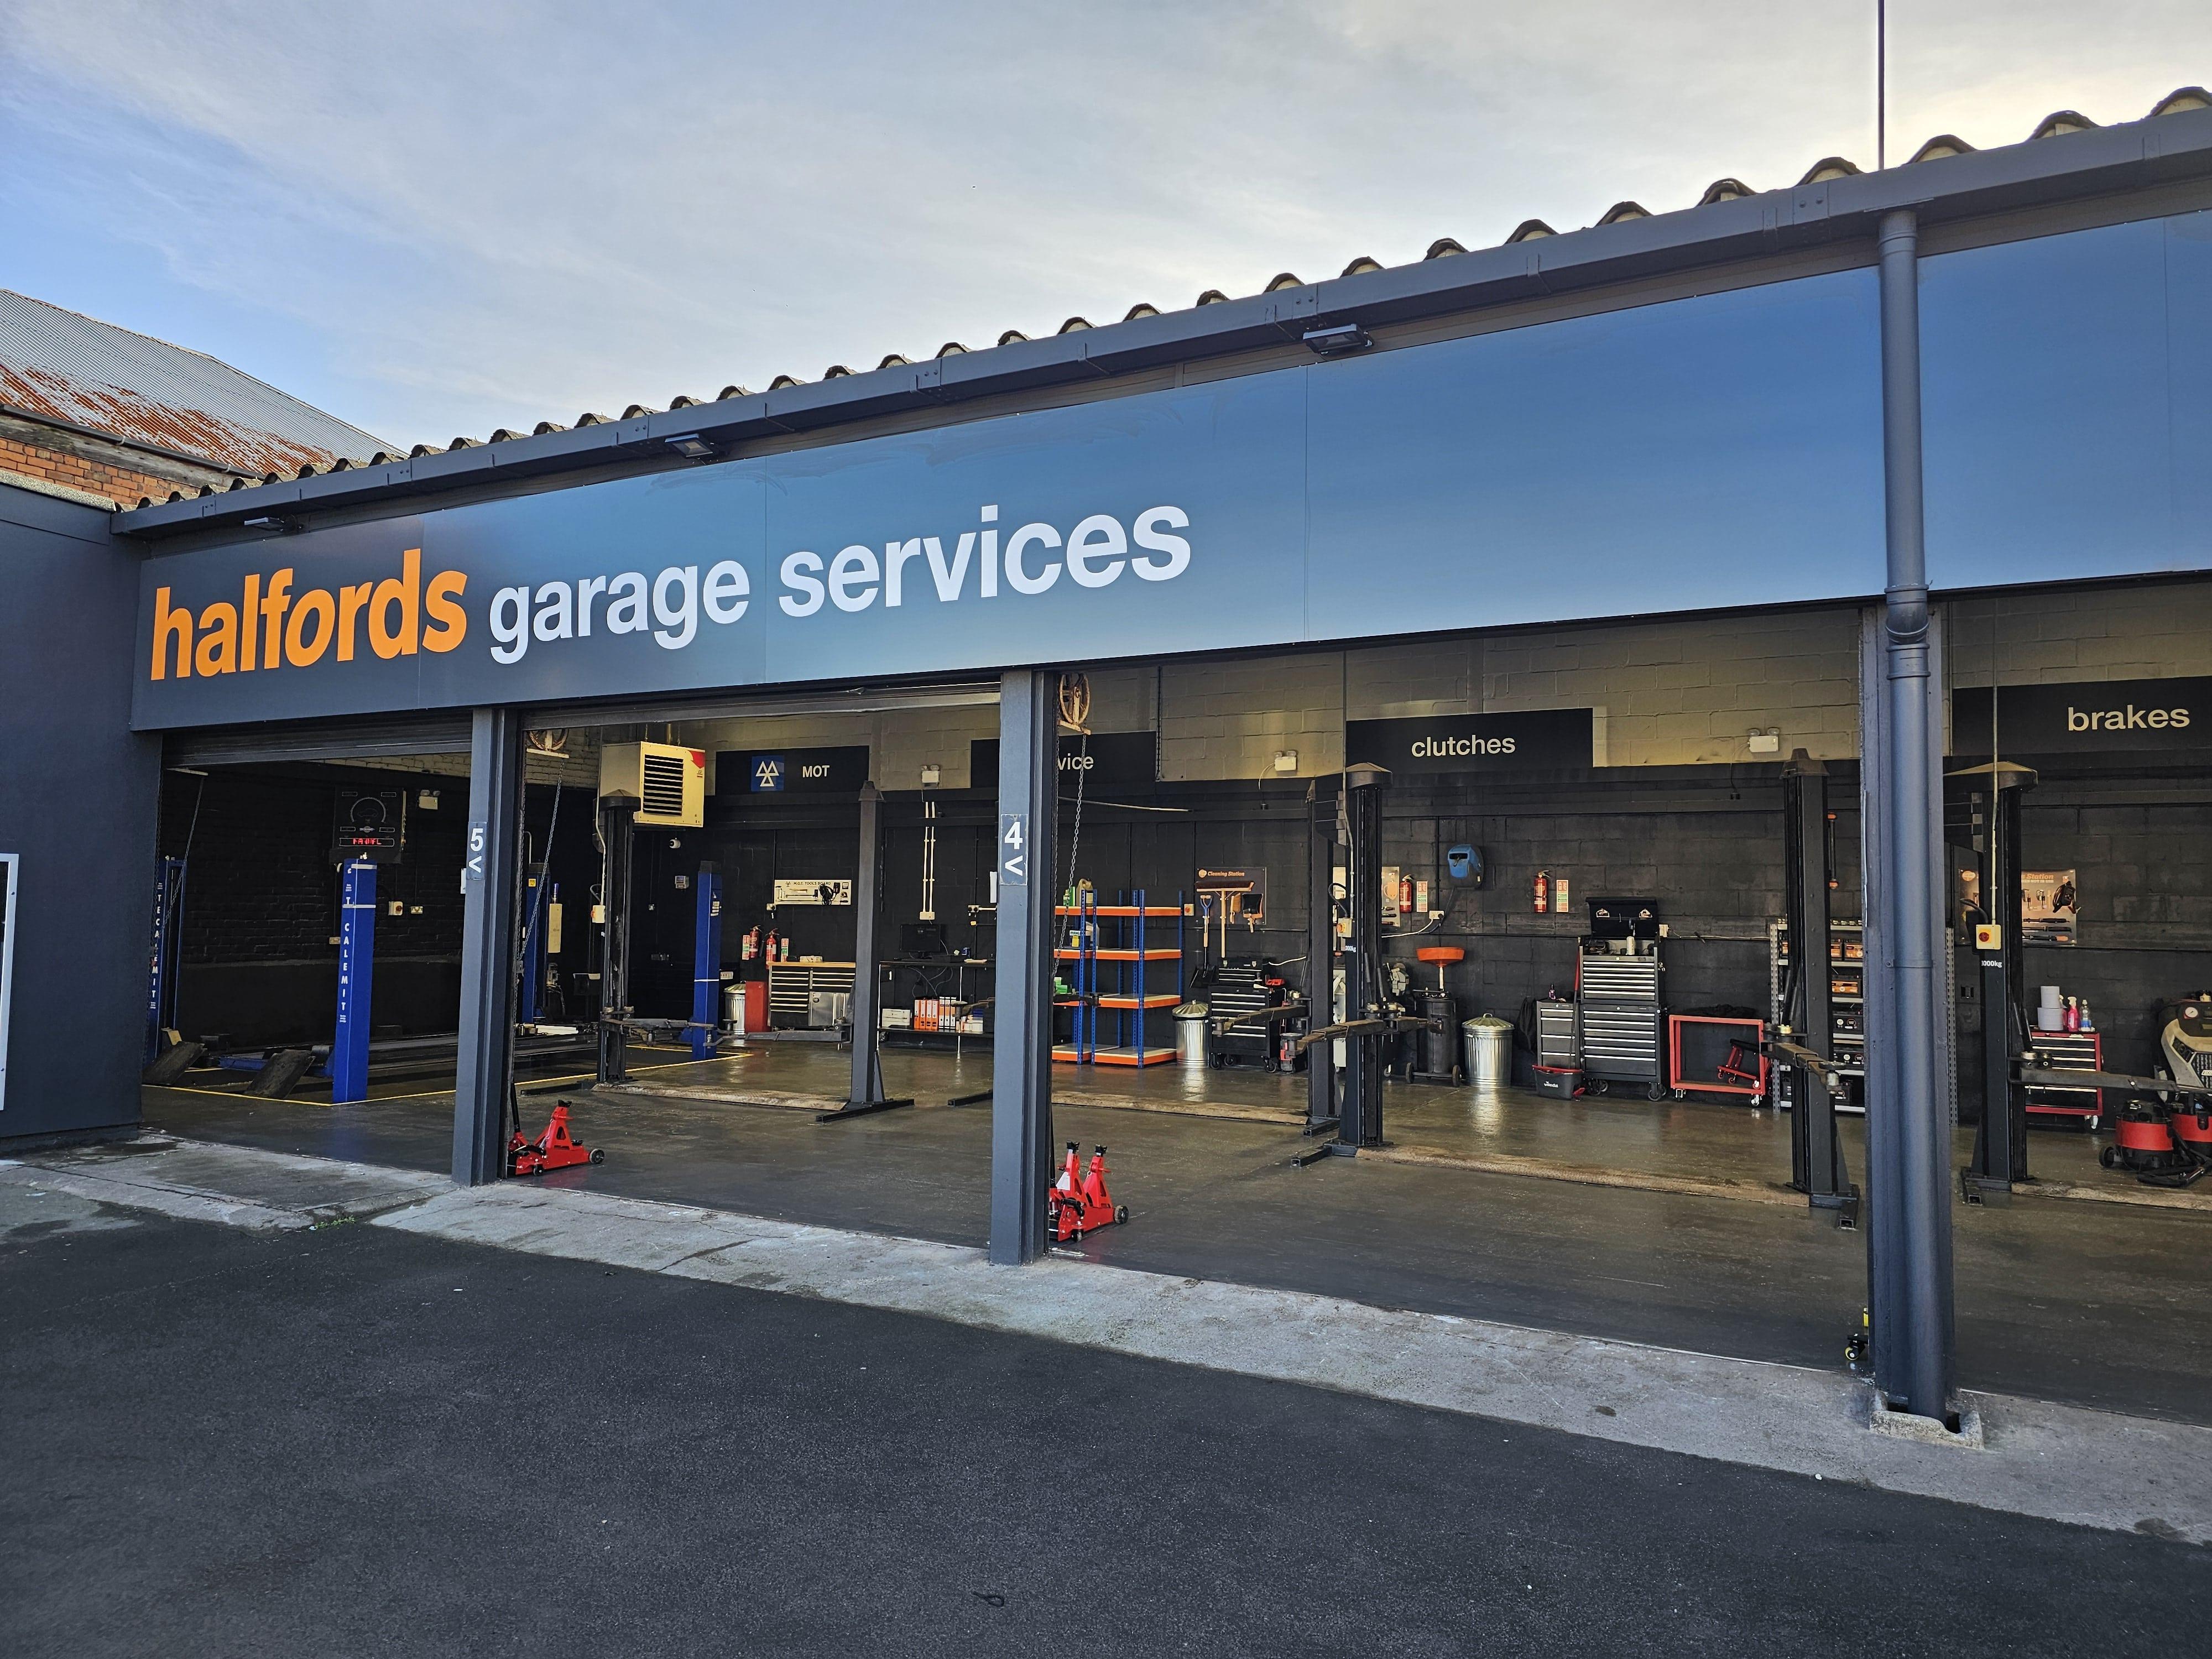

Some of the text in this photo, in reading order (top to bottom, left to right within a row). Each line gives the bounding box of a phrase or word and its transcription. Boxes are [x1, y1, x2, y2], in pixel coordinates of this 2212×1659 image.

[151, 505, 1191, 681] halfords garage services
[2068, 705, 2190, 731] brakes
[1411, 734, 1516, 757] clutches
[802, 765, 830, 778] MOT
[470, 828, 484, 852] 5
[1004, 821, 1023, 849] 4
